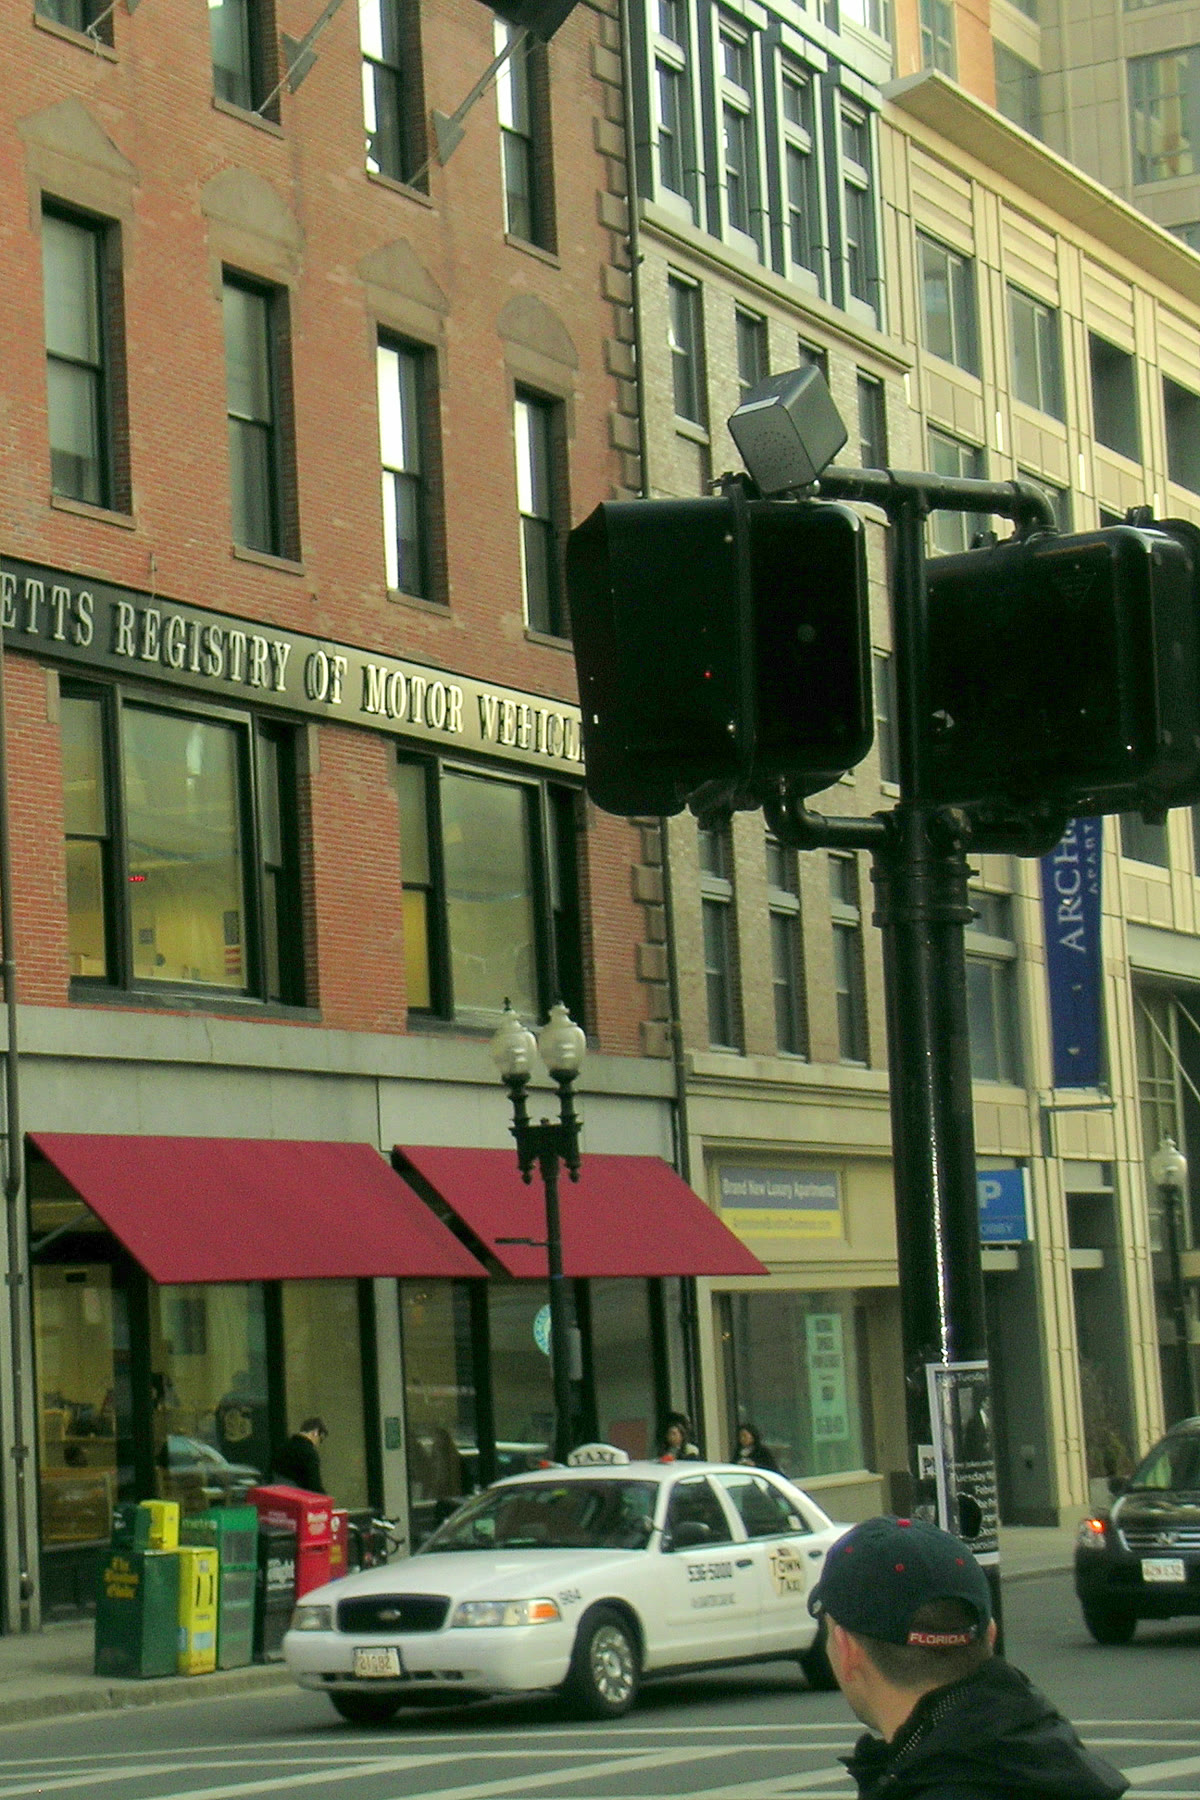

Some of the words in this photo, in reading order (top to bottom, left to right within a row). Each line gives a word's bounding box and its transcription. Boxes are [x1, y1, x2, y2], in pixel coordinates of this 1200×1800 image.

[114, 600, 291, 692] REGISTRY
[305, 649, 348, 705] OF
[362, 663, 464, 733] MOTOR
[478, 692, 585, 763] VEHICL
[574, 1451, 616, 1465] TAXI
[770, 1556, 802, 1577] TOWN
[777, 1576, 801, 1595] TAXI
[910, 1632, 966, 1645] FLORIDA
